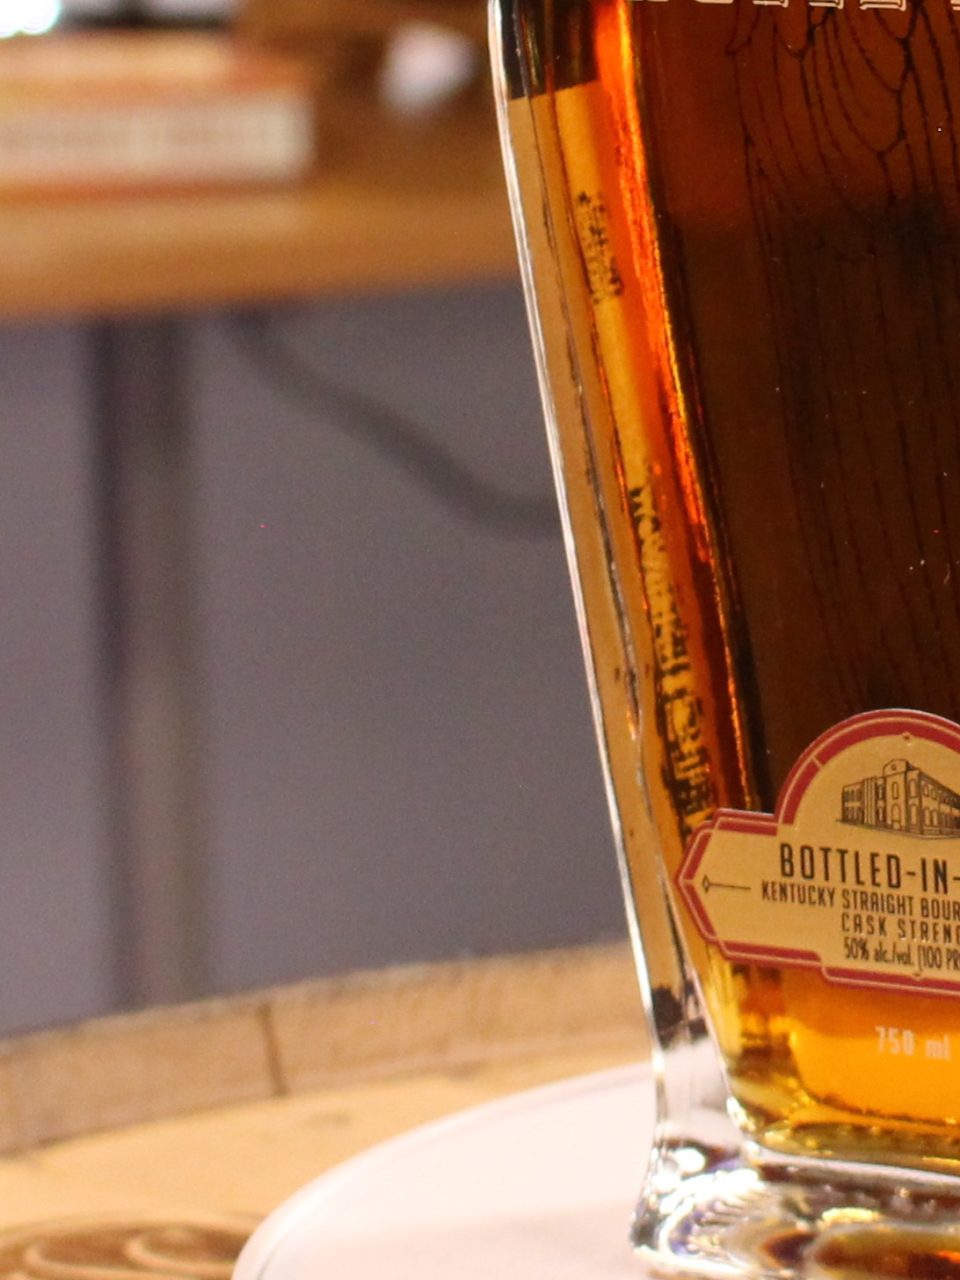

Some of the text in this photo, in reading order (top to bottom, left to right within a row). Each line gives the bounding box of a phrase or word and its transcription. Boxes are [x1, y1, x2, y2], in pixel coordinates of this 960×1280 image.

[761, 879, 836, 908] KENTUCKY
[841, 888, 915, 917] STRAIGHT
[841, 911, 888, 936] CASK
[844, 935, 870, 960] 50%
[875, 1025, 952, 1062] 750 ml
